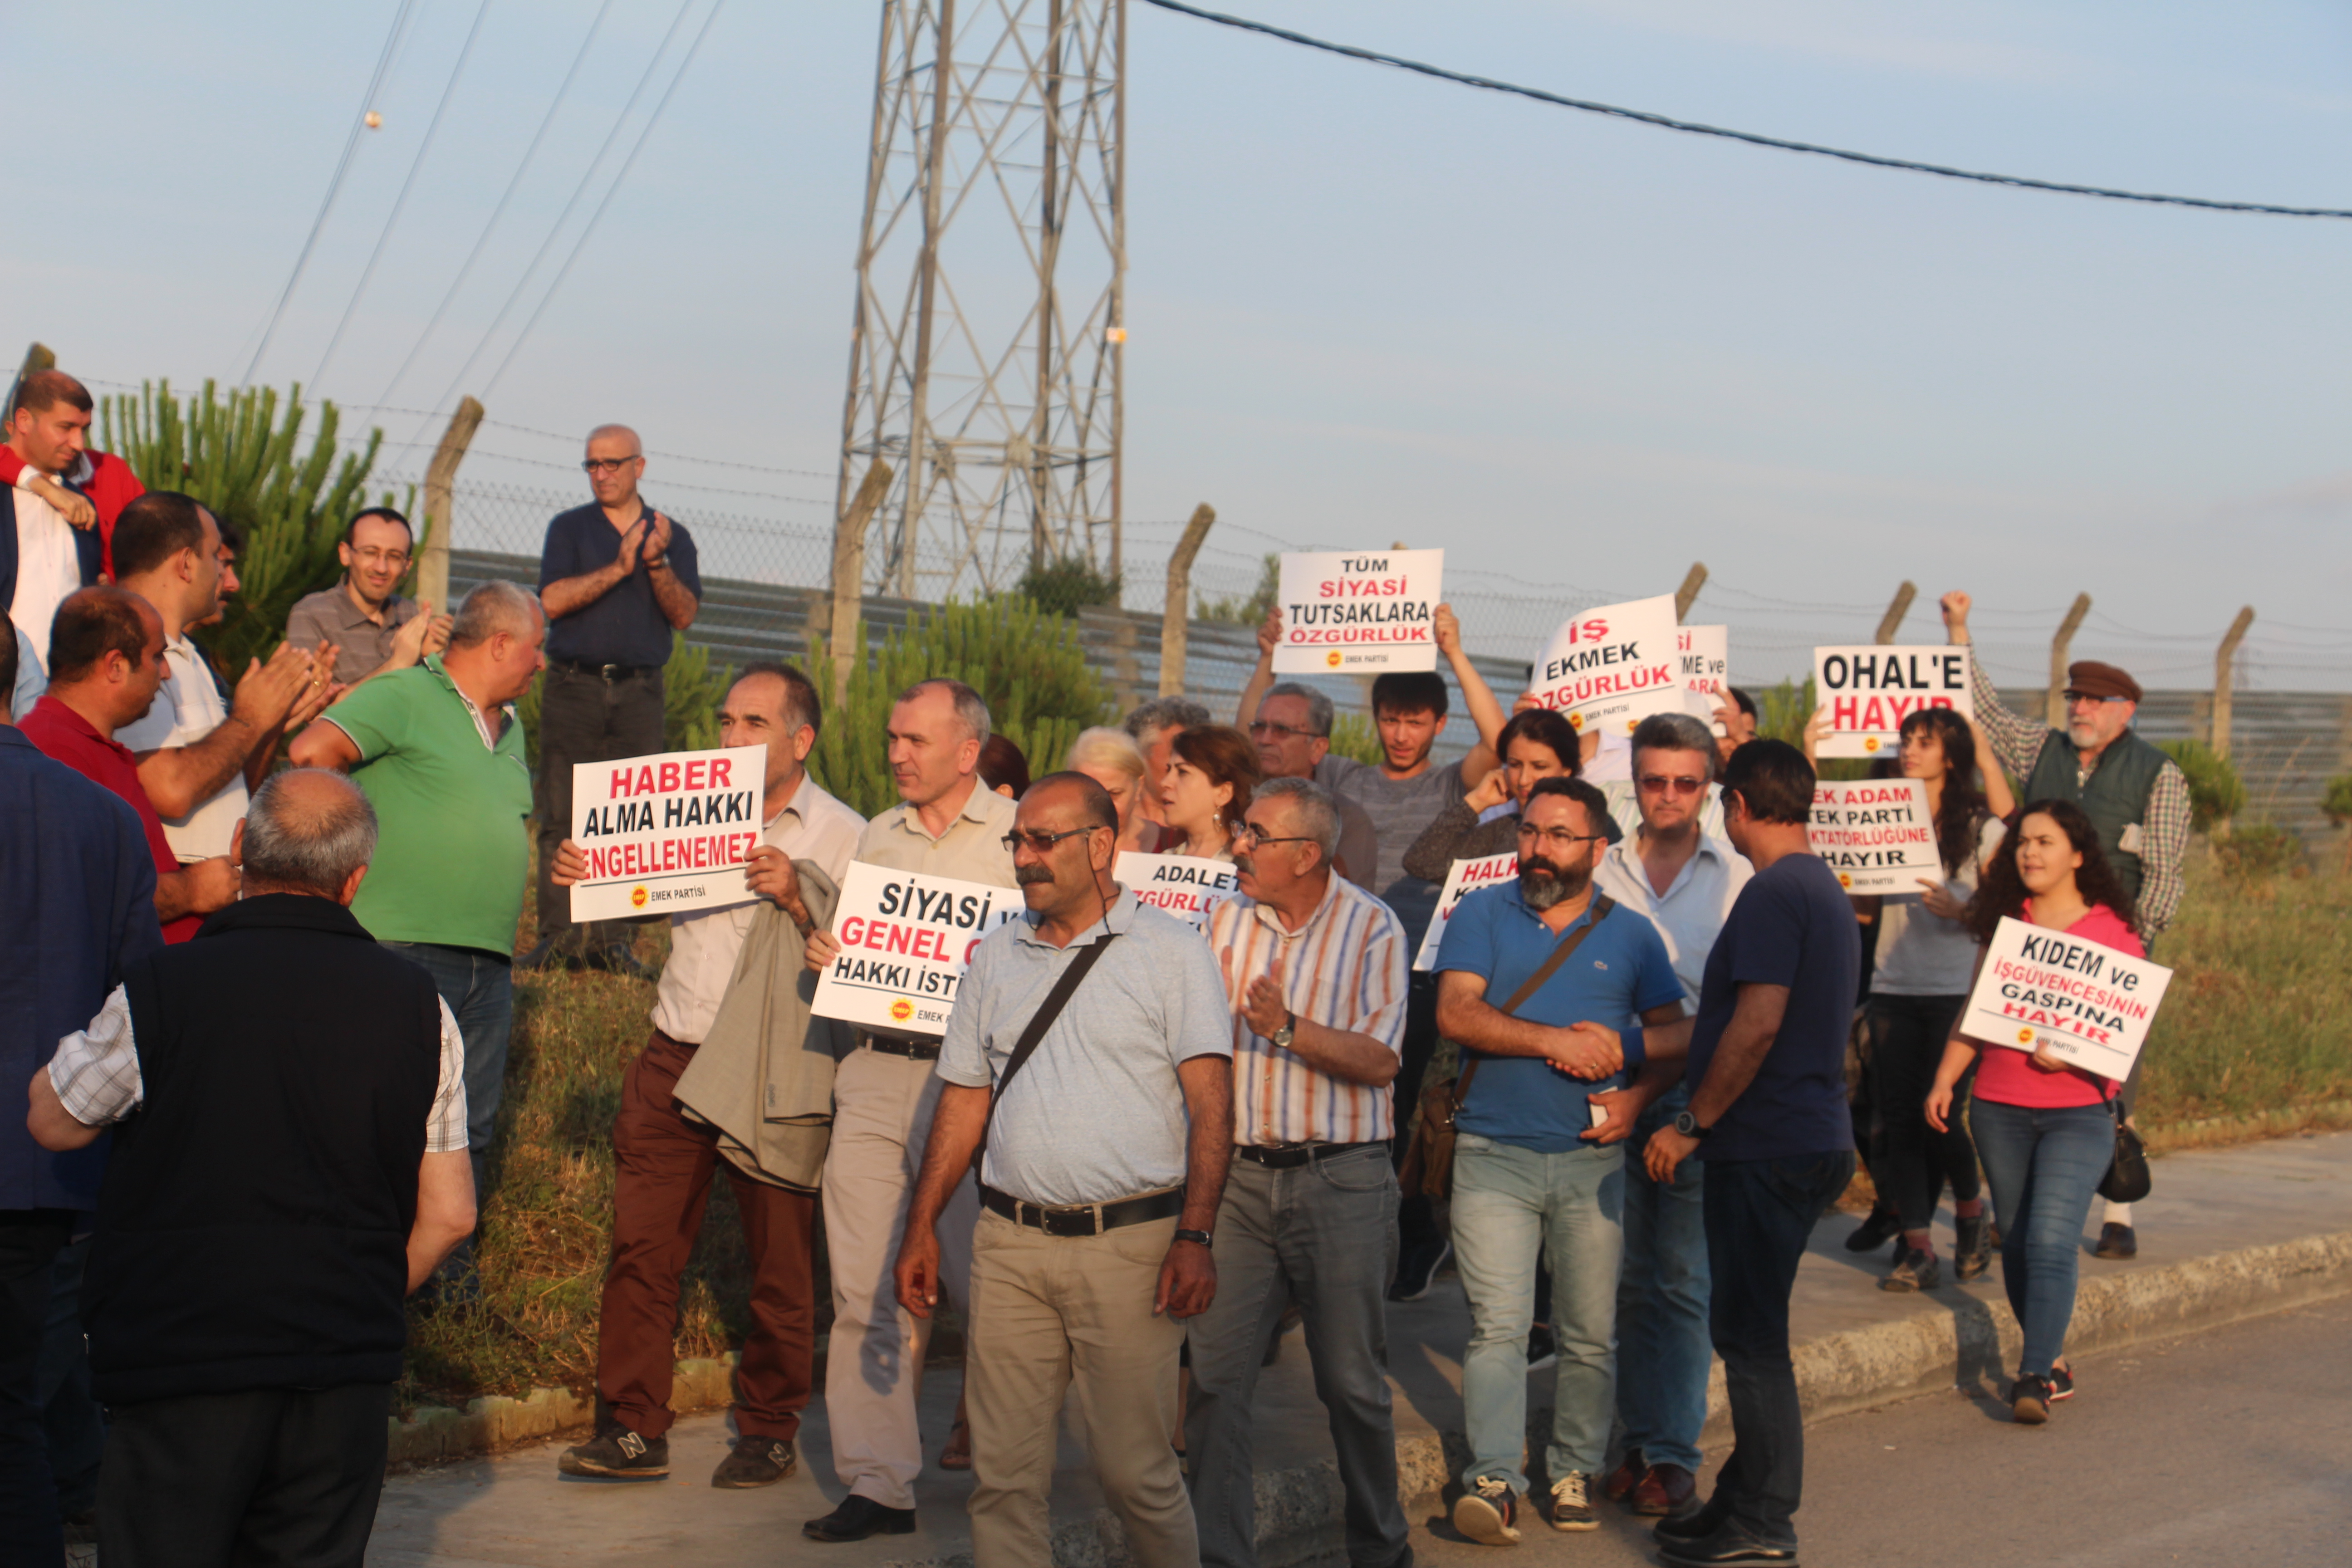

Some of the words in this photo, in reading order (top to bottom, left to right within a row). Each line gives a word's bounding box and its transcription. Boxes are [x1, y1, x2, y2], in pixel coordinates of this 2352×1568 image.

[1342, 556, 1389, 573] TÜM
[1319, 575, 1407, 598] SİYASİ
[1290, 600, 1430, 624] TUTSAKLARA
[1290, 624, 1428, 643] ÖZGÜRLÜK
[1569, 618, 1609, 644] İŞ
[1547, 641, 1640, 681] EKMEK
[1680, 655, 1704, 674] ME
[1823, 655, 1963, 689] OHAL'E
[609, 758, 732, 799] HABER
[1845, 786, 1913, 804] ADAM
[582, 800, 654, 838] ALMA
[664, 790, 753, 829] HAKKI
[1847, 804, 1914, 825] PARTİ
[1821, 850, 1907, 867] HAYIR
[651, 890, 671, 902] EMEK
[674, 884, 706, 900] PARTİSİ
[878, 878, 992, 931] SİYASİ
[840, 916, 951, 963] GENEL
[834, 956, 911, 988] HAKKI
[2021, 934, 2106, 978] KIDEM
[2112, 967, 2139, 991] ve
[1993, 956, 2149, 1020] İŞGÜVENCESİNİN
[917, 1009, 944, 1023] EMEK
[2001, 984, 2124, 1032] GASPINA
[2003, 1002, 2112, 1045] HAYIR
